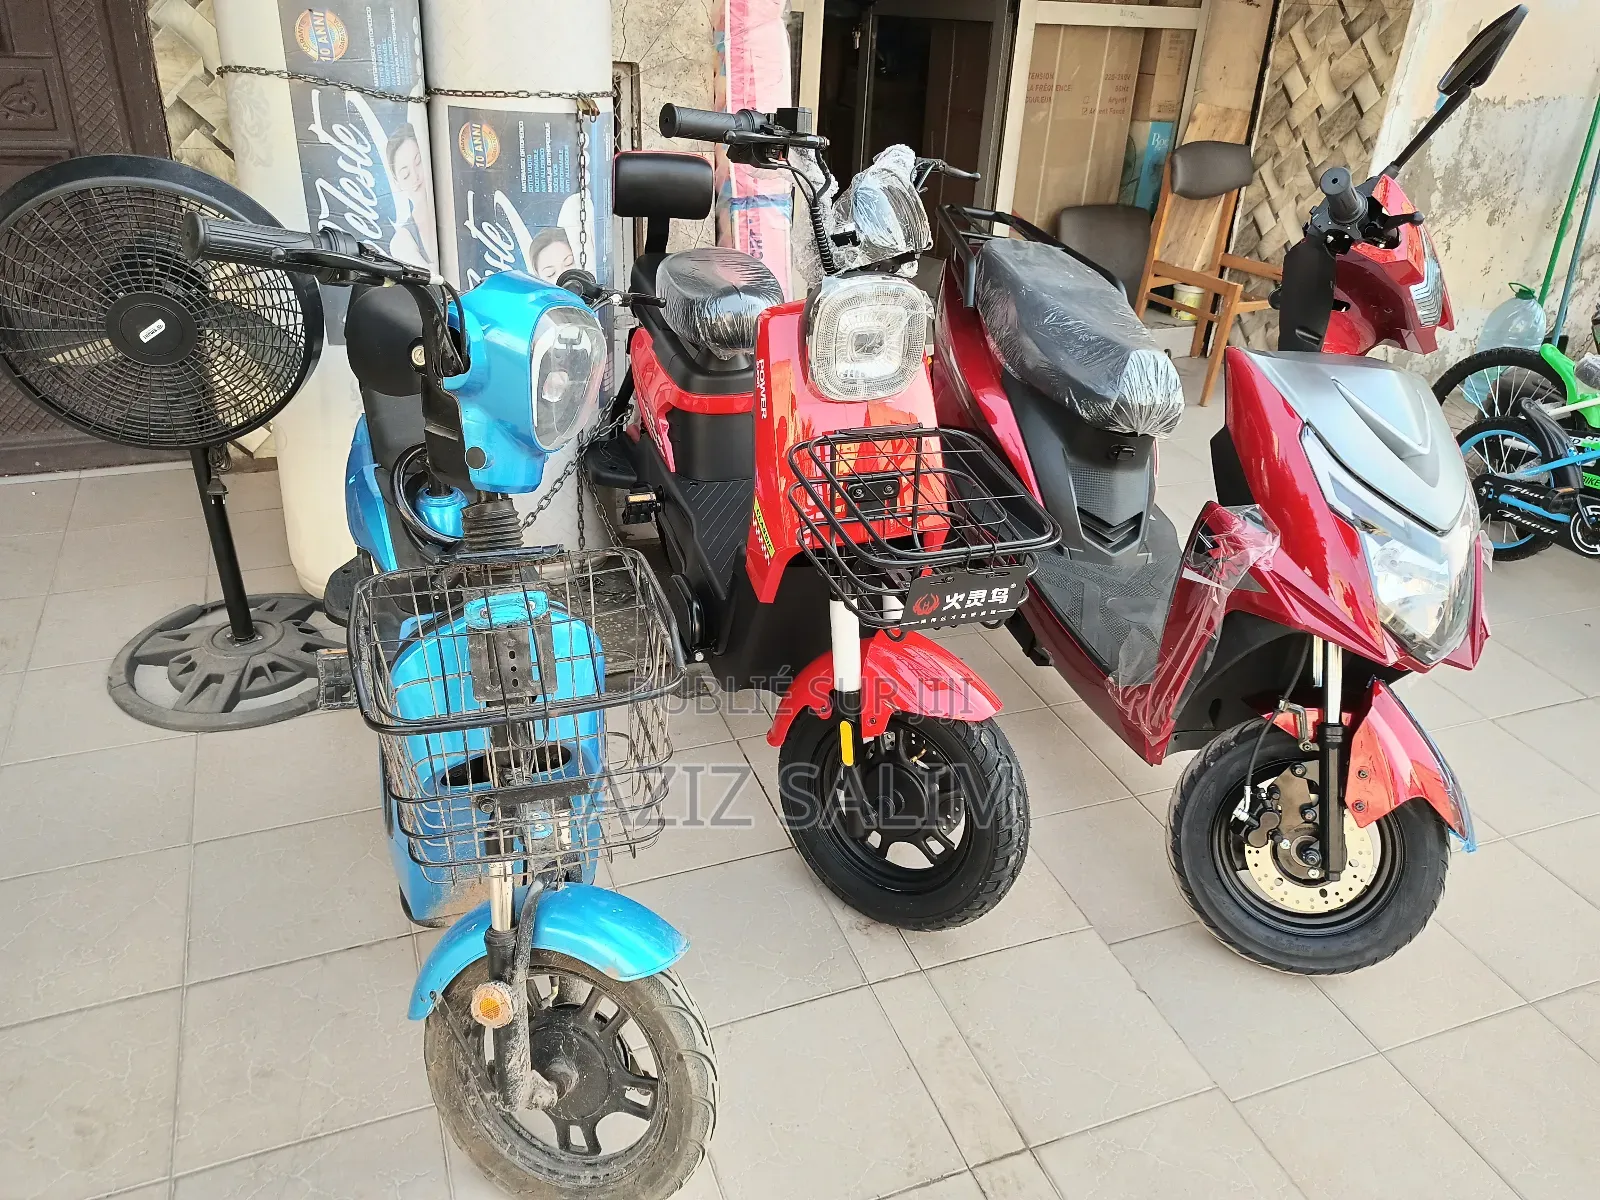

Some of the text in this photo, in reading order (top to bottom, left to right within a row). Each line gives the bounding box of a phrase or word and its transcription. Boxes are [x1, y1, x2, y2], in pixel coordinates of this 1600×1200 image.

[312, 11, 332, 62] 10 ANNI
[471, 123, 485, 168] 10 ANNI
[758, 358, 769, 420] POWER
[942, 587, 1009, 611] 火灵鸟
